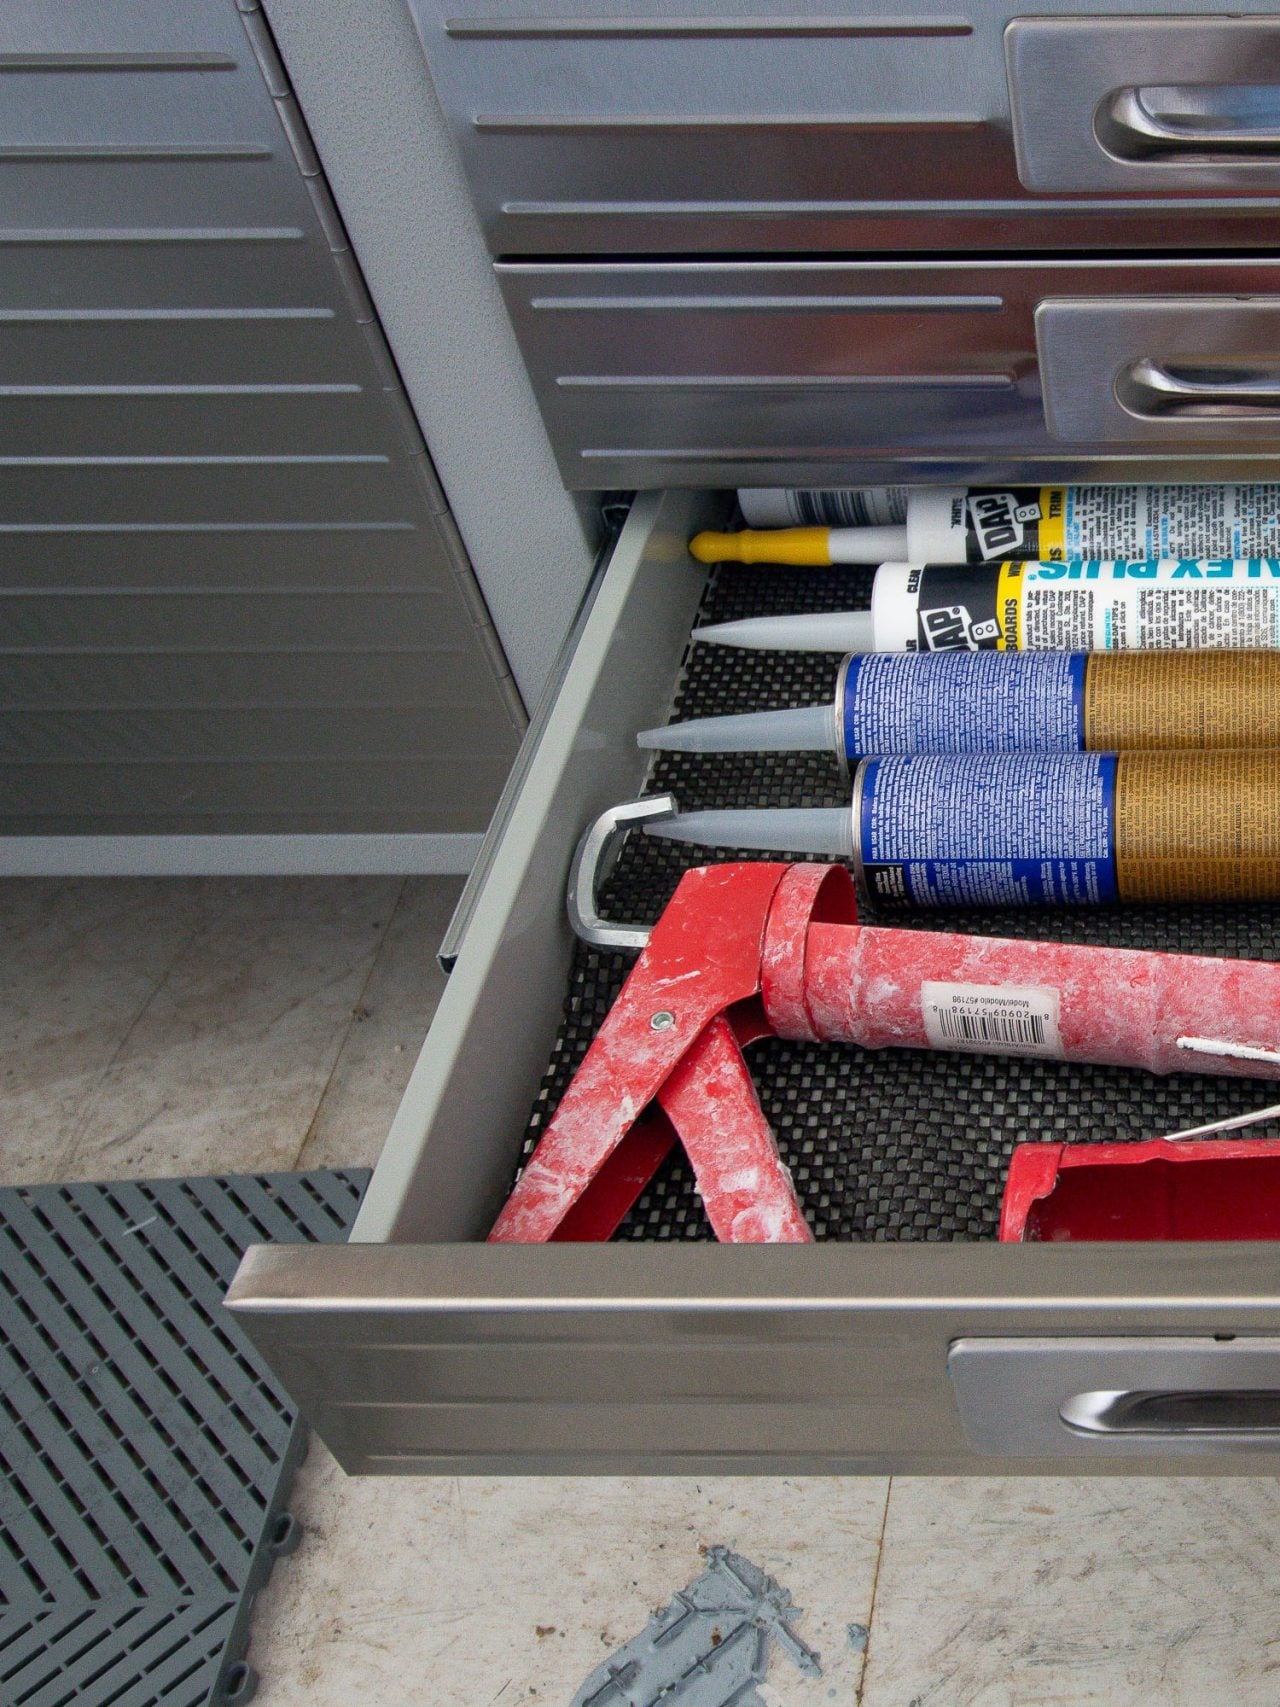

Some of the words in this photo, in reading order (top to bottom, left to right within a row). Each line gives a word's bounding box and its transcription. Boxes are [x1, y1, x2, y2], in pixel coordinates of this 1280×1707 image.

[975, 495, 1017, 549] DAP
[907, 569, 921, 593] CLEAR
[926, 610, 970, 651] AP
[952, 995, 978, 1004] #57198
[980, 997, 1029, 1008] Model/Modelo
[952, 1006, 988, 1016] 57198
[993, 1009, 1030, 1019] 20909
